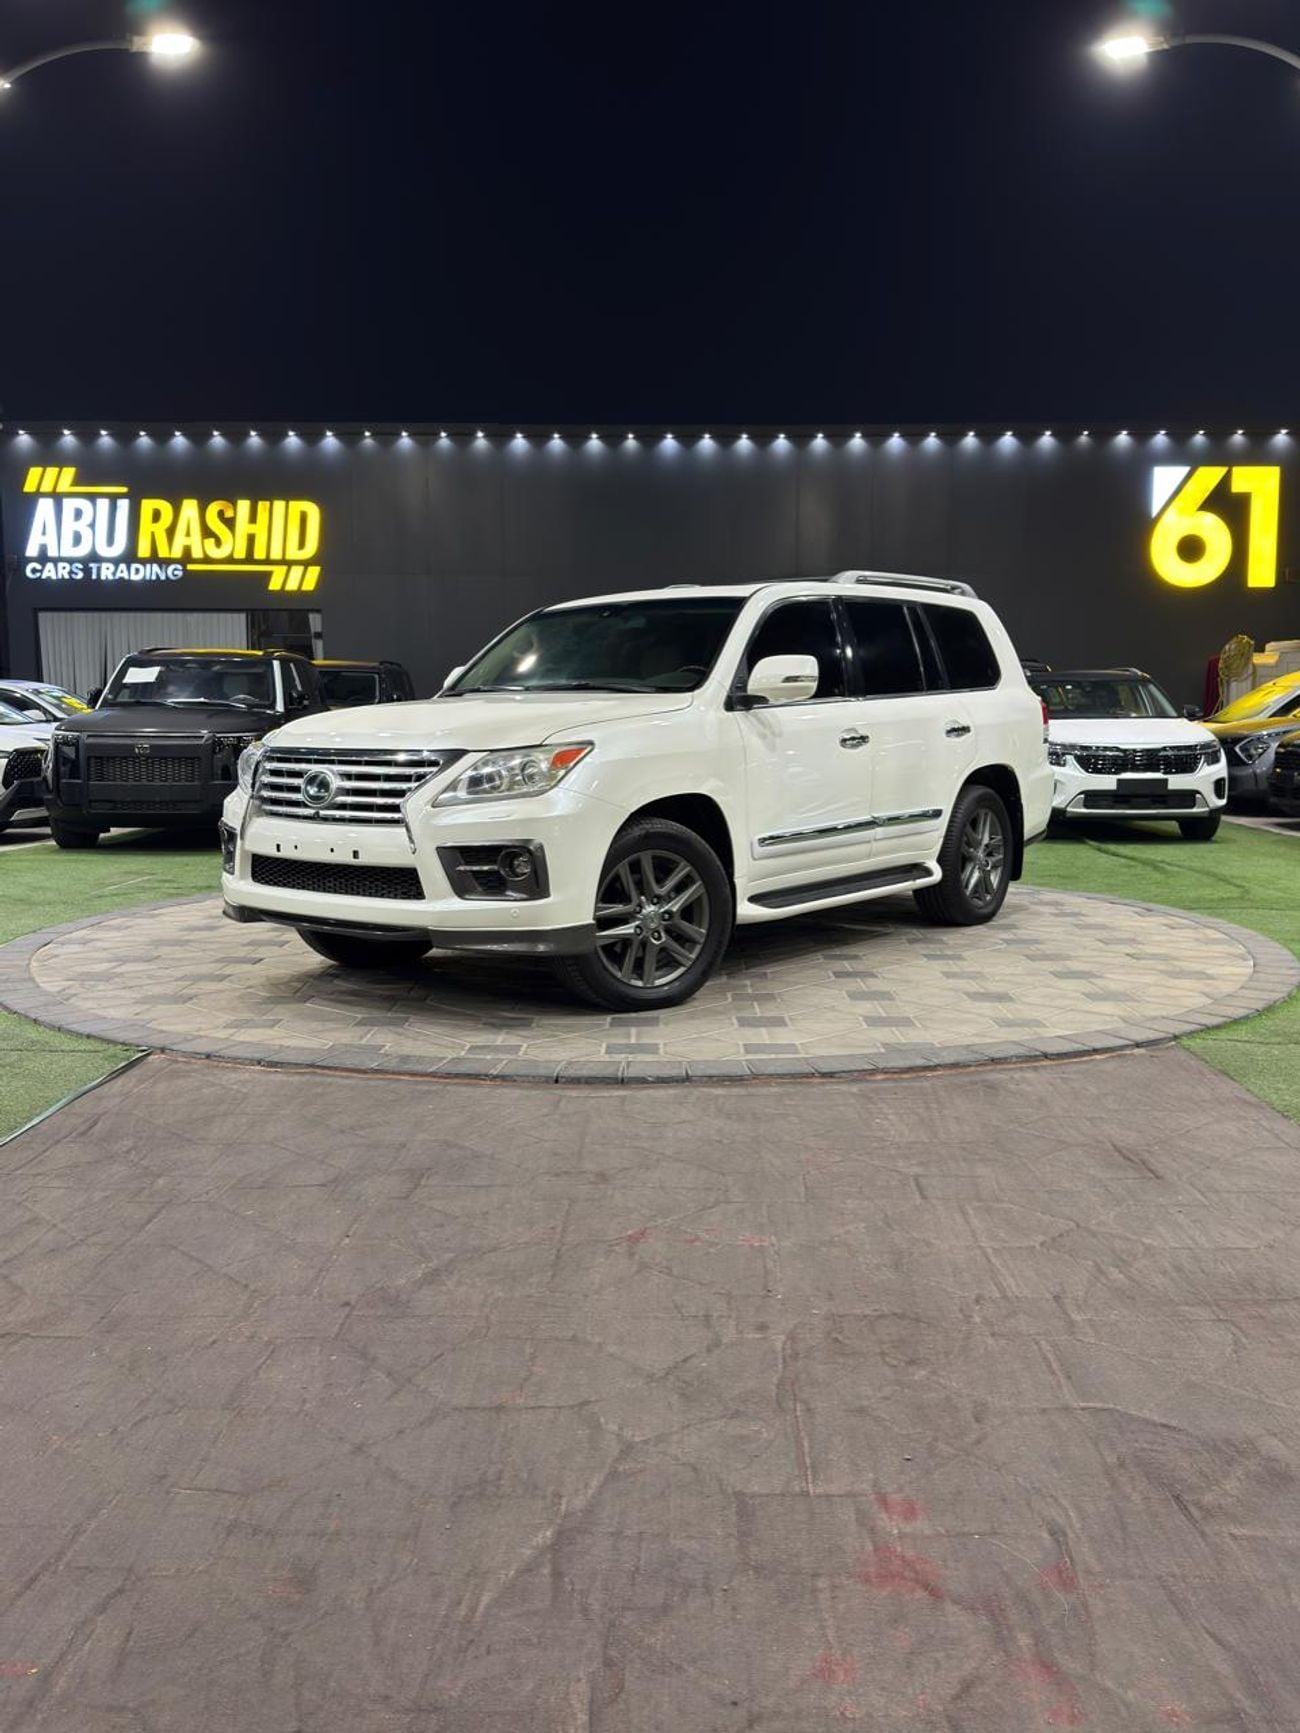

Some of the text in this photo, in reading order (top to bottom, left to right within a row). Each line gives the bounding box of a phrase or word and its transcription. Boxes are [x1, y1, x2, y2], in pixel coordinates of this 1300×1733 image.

[24, 498, 321, 560] ABU RASHID
[1150, 466, 1281, 588] 61
[25, 562, 184, 581] CARS TRADING
